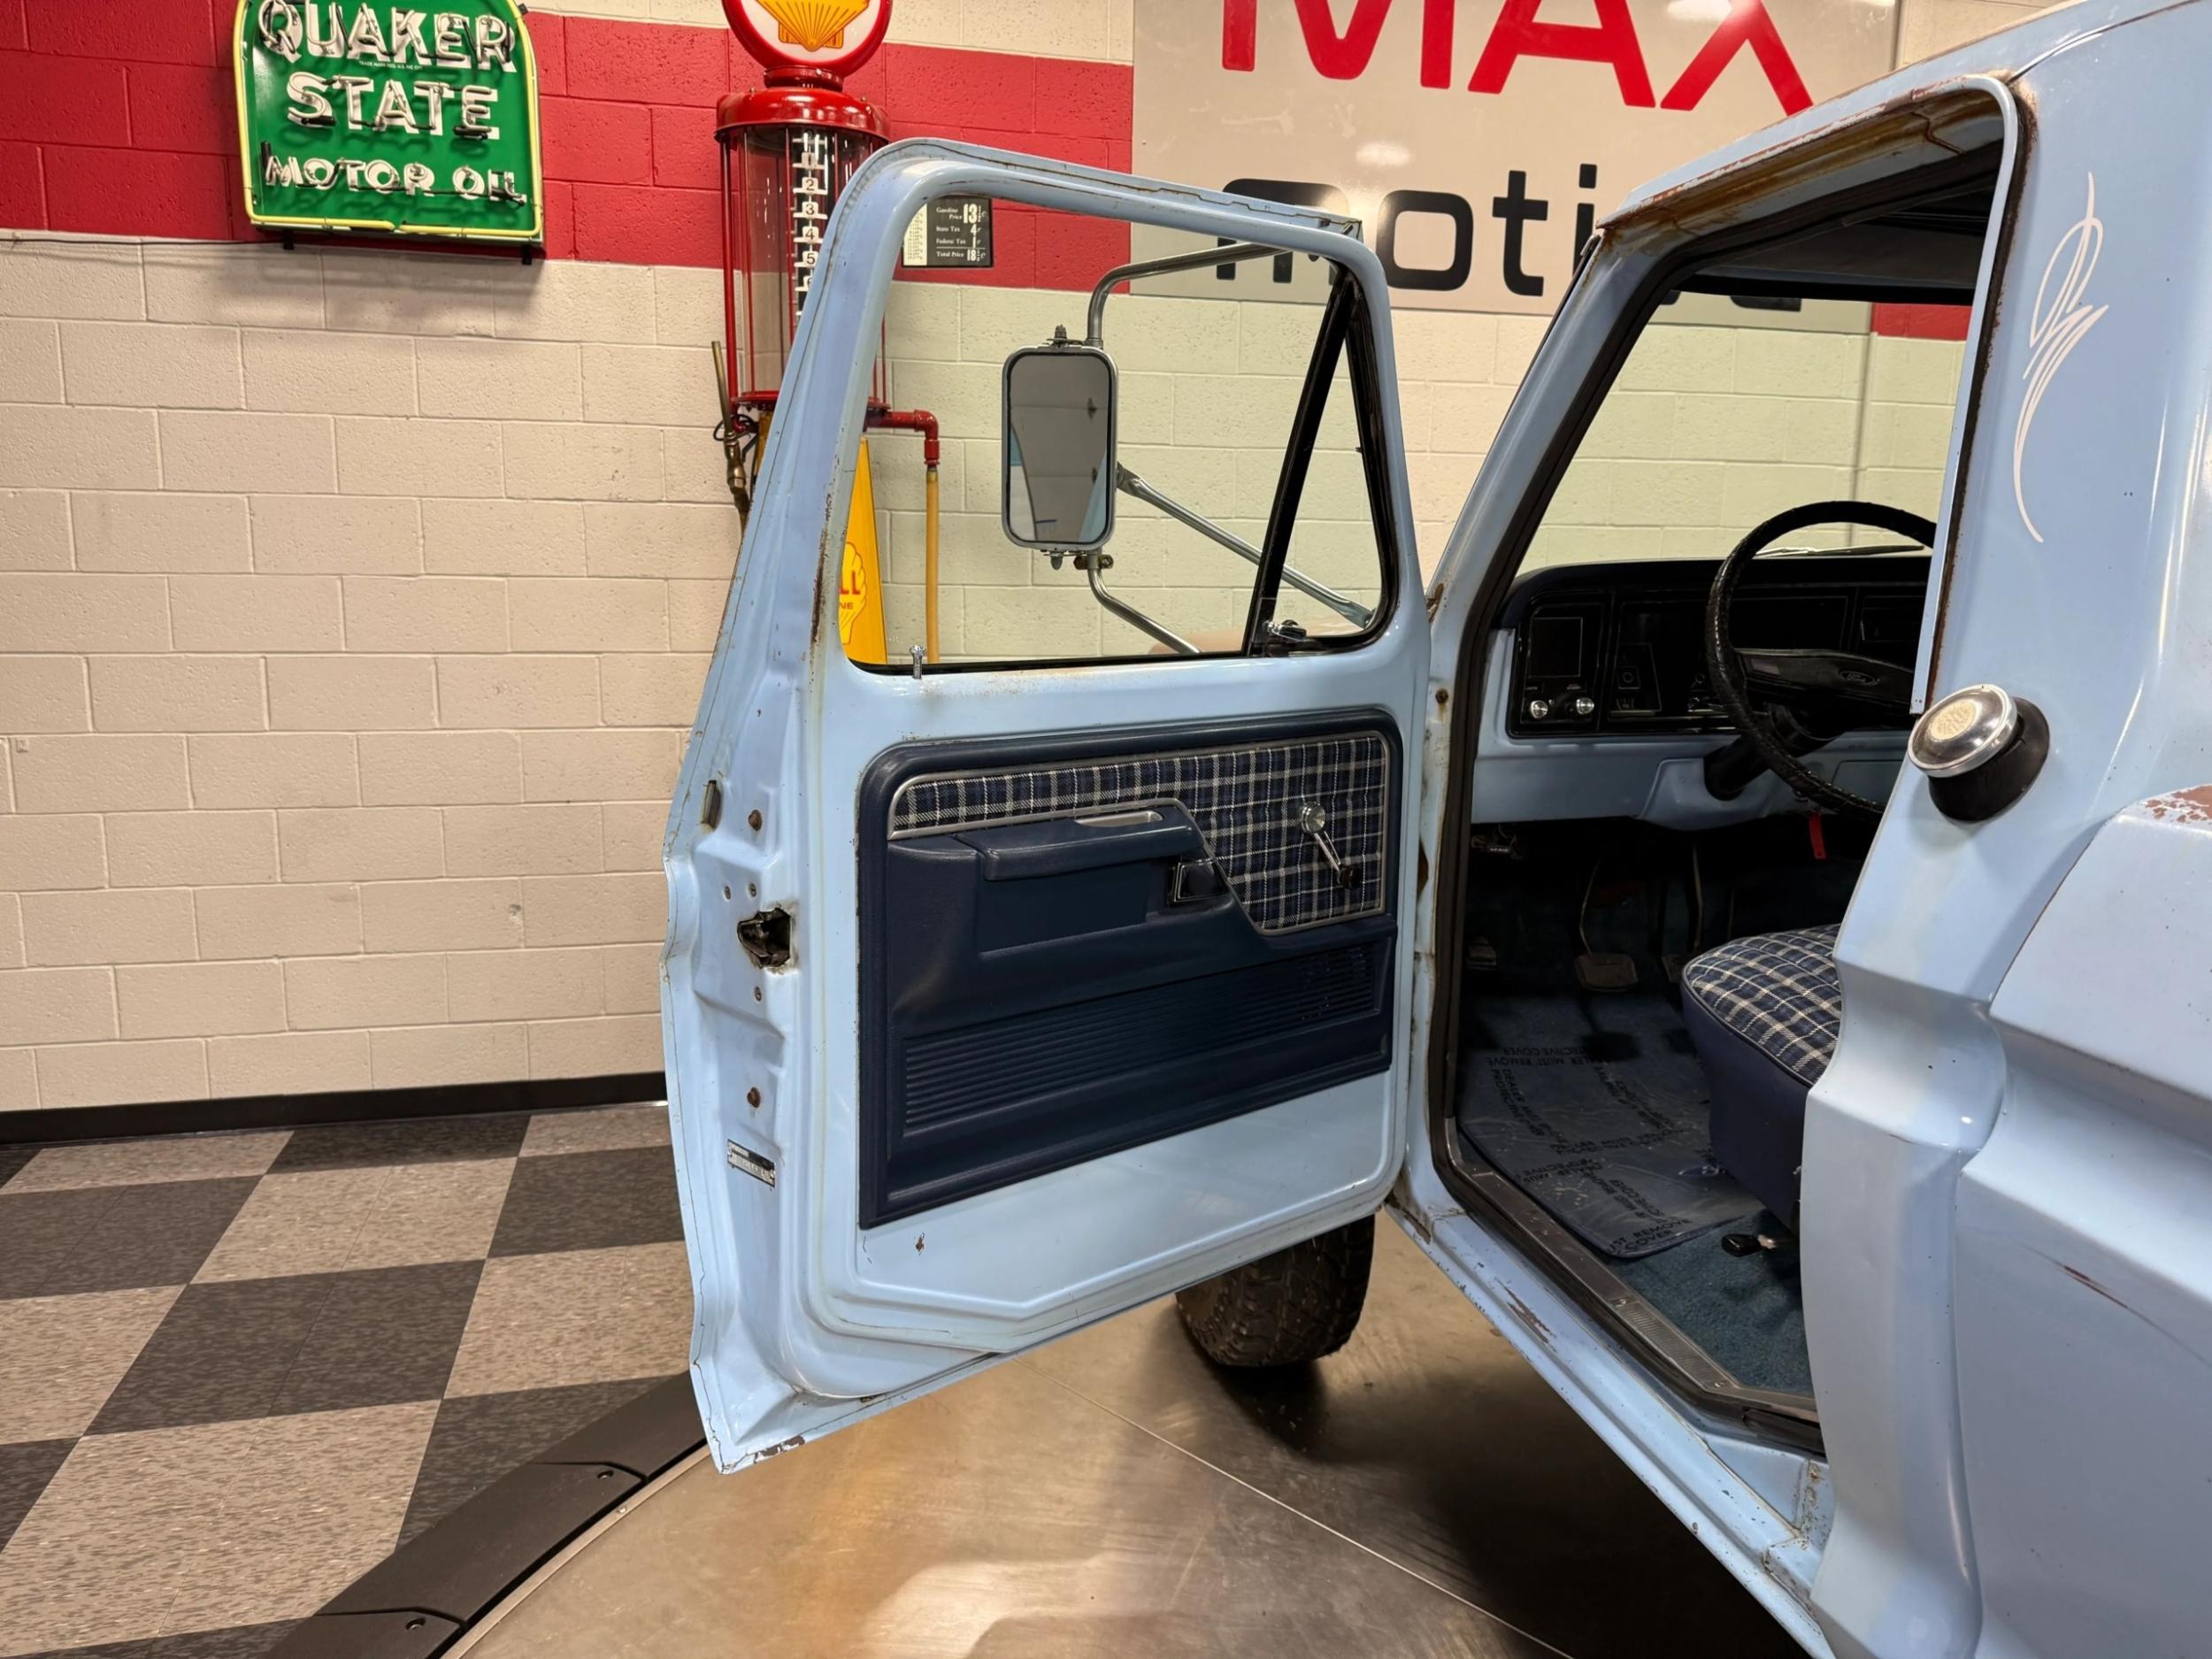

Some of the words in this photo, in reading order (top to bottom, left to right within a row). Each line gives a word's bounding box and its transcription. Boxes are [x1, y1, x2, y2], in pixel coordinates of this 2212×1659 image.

[257, 0, 518, 73] QUAKER
[287, 71, 501, 140] STATE
[264, 155, 435, 197] MOTOR
[452, 165, 528, 206] OIL
[806, 180, 815, 191] 2
[806, 204, 815, 215] 3
[805, 228, 815, 240] 4
[806, 253, 816, 265] 5
